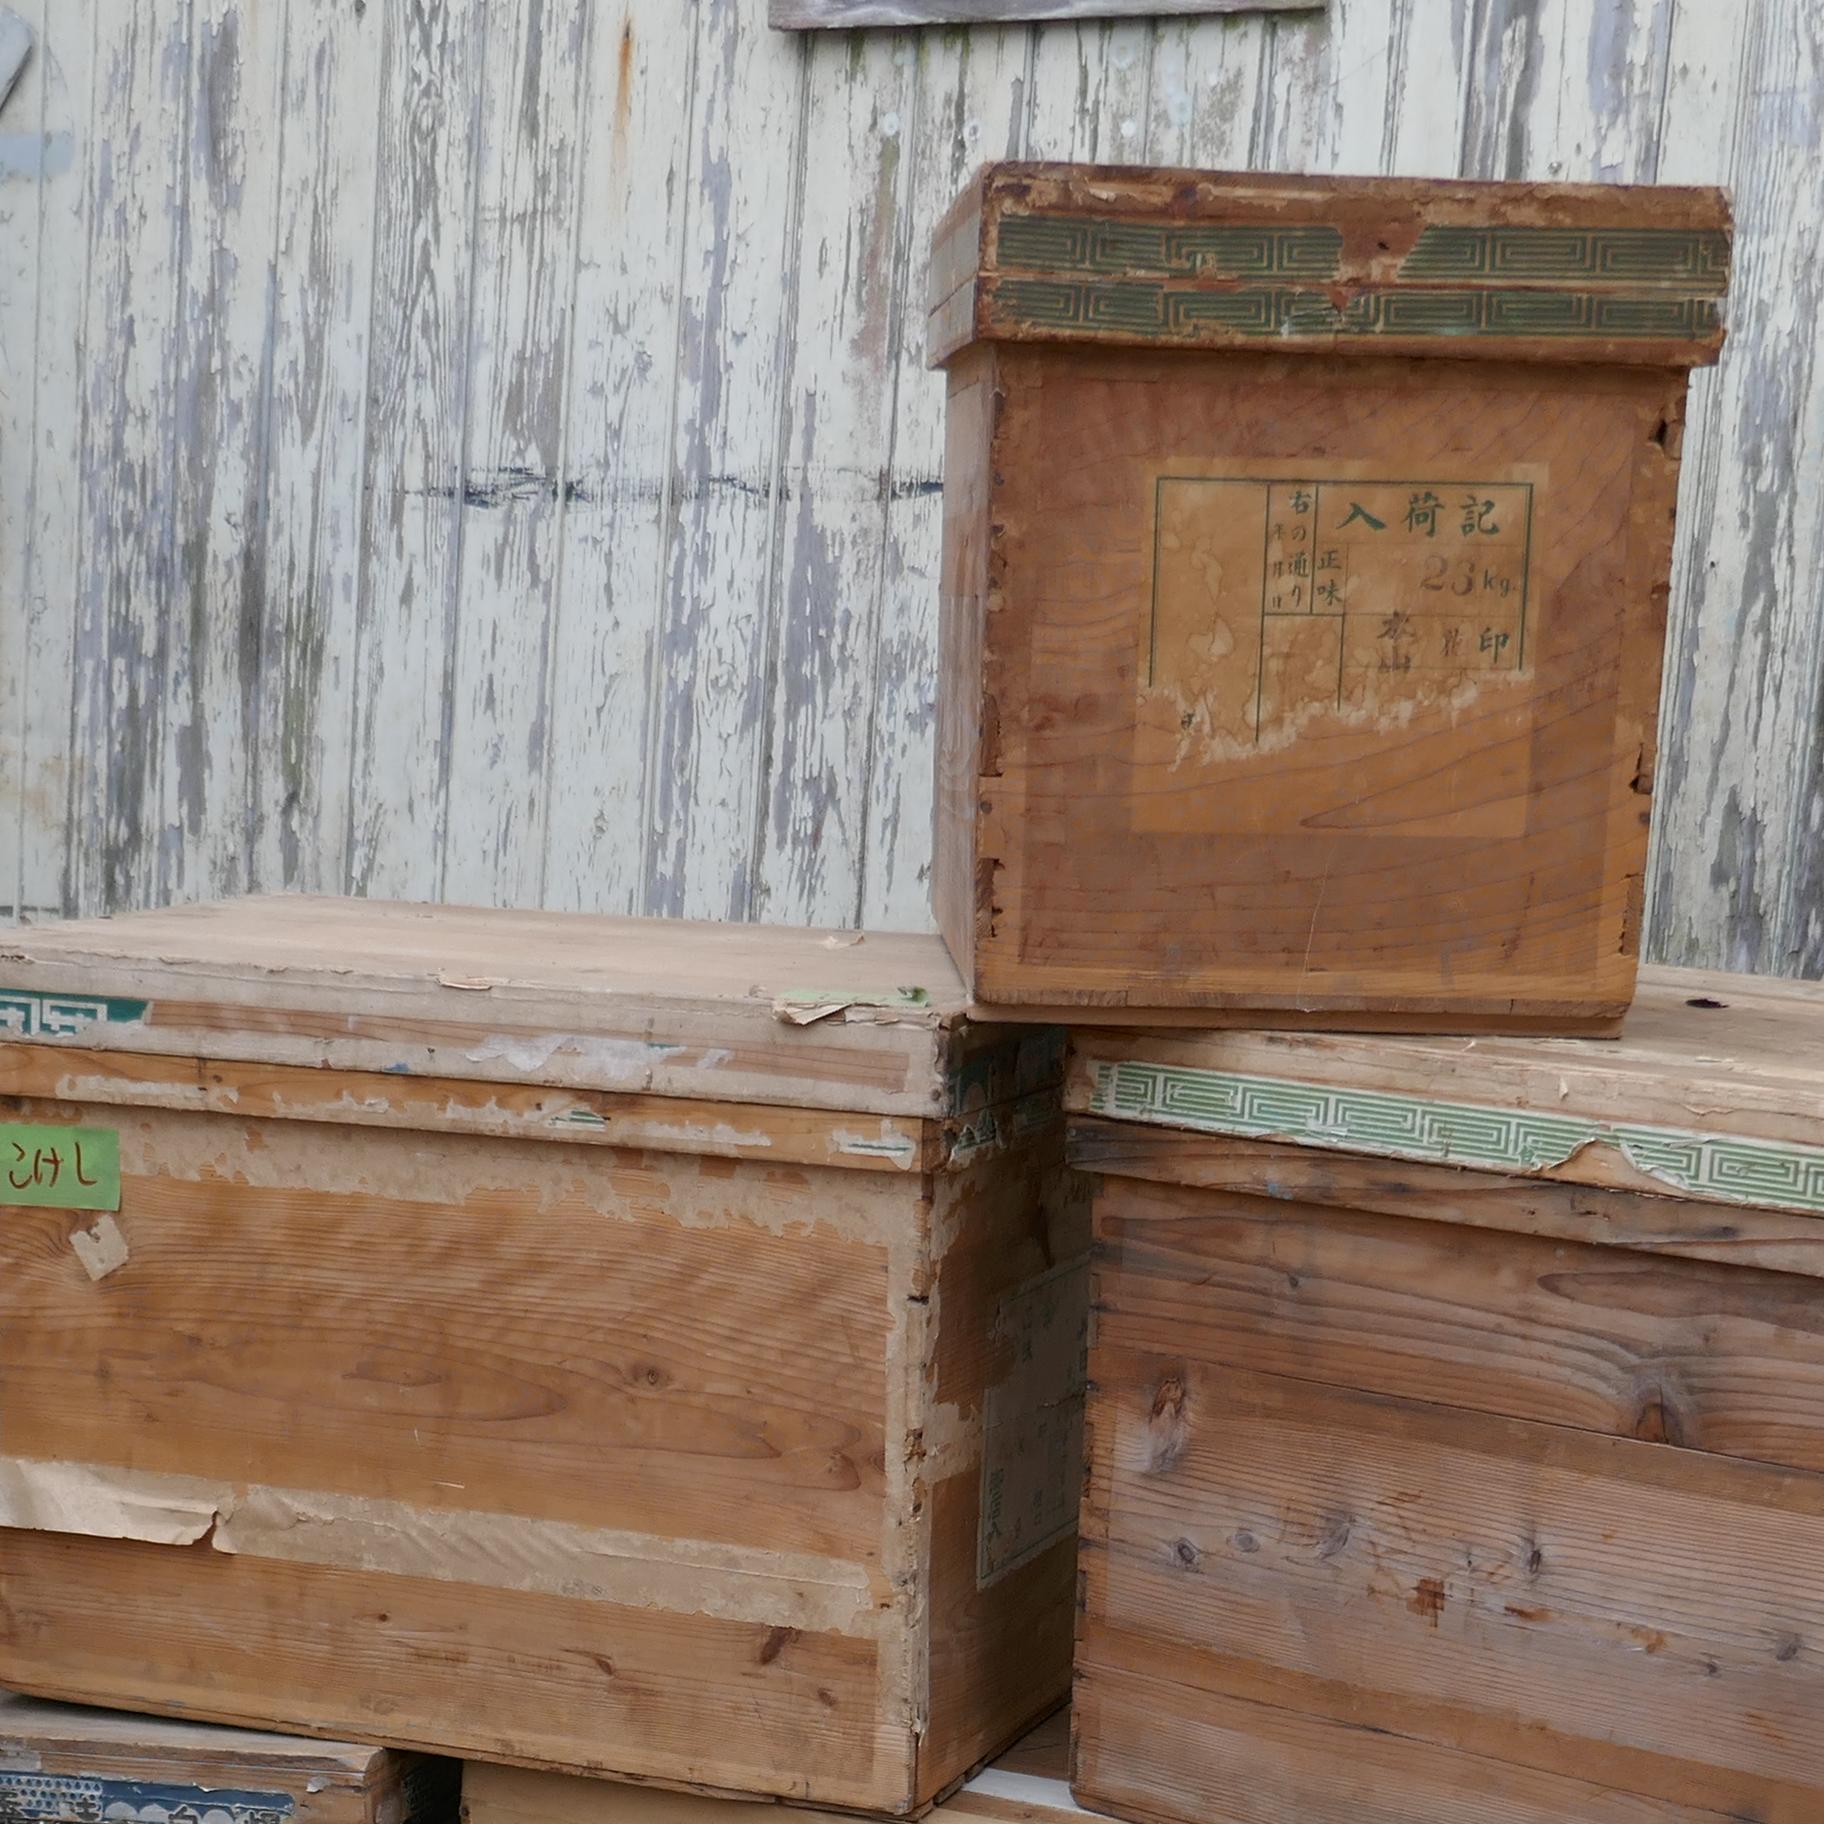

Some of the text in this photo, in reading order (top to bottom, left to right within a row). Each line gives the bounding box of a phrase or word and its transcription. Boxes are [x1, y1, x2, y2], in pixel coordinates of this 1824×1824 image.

[1336, 492, 1500, 538] 入荷記
[1317, 551, 1343, 606] 正味
[8, 1141, 98, 1190] こけし
